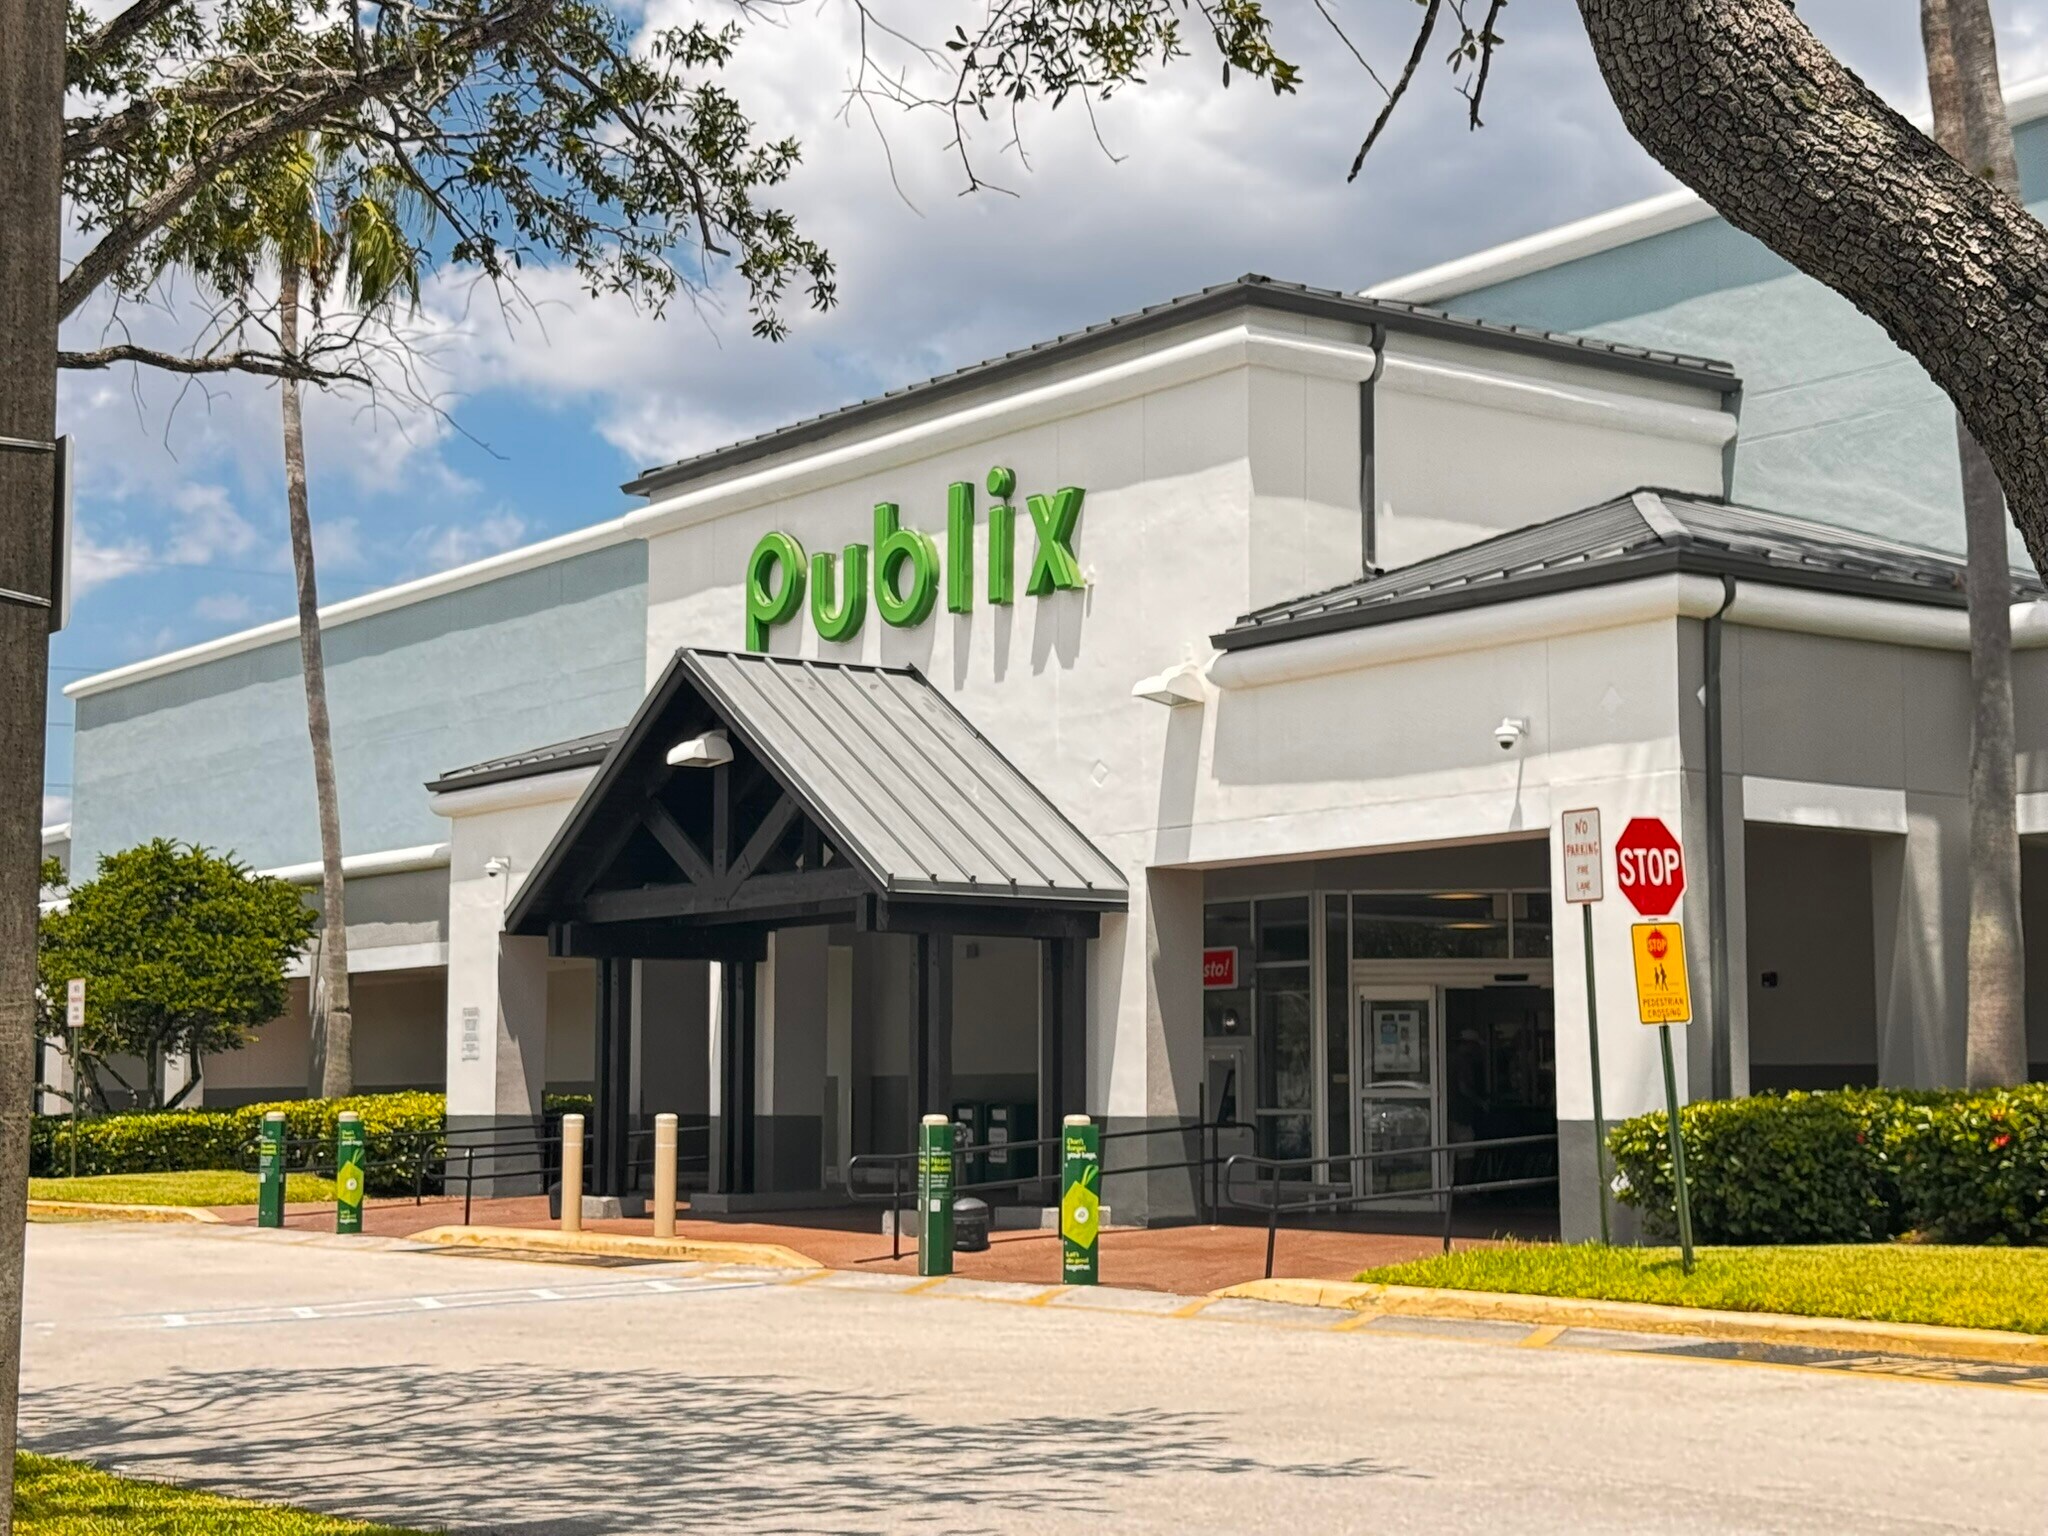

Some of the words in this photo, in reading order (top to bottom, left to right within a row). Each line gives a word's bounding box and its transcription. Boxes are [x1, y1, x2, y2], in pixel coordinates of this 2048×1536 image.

[1575, 820, 1588, 834] NO
[1566, 842, 1599, 856] PARKING
[1619, 847, 1680, 887] STOP
[1647, 938, 1667, 952] STOP
[1643, 997, 1685, 1008] PEDESTRIAN
[1647, 1008, 1682, 1018] CROSSING
